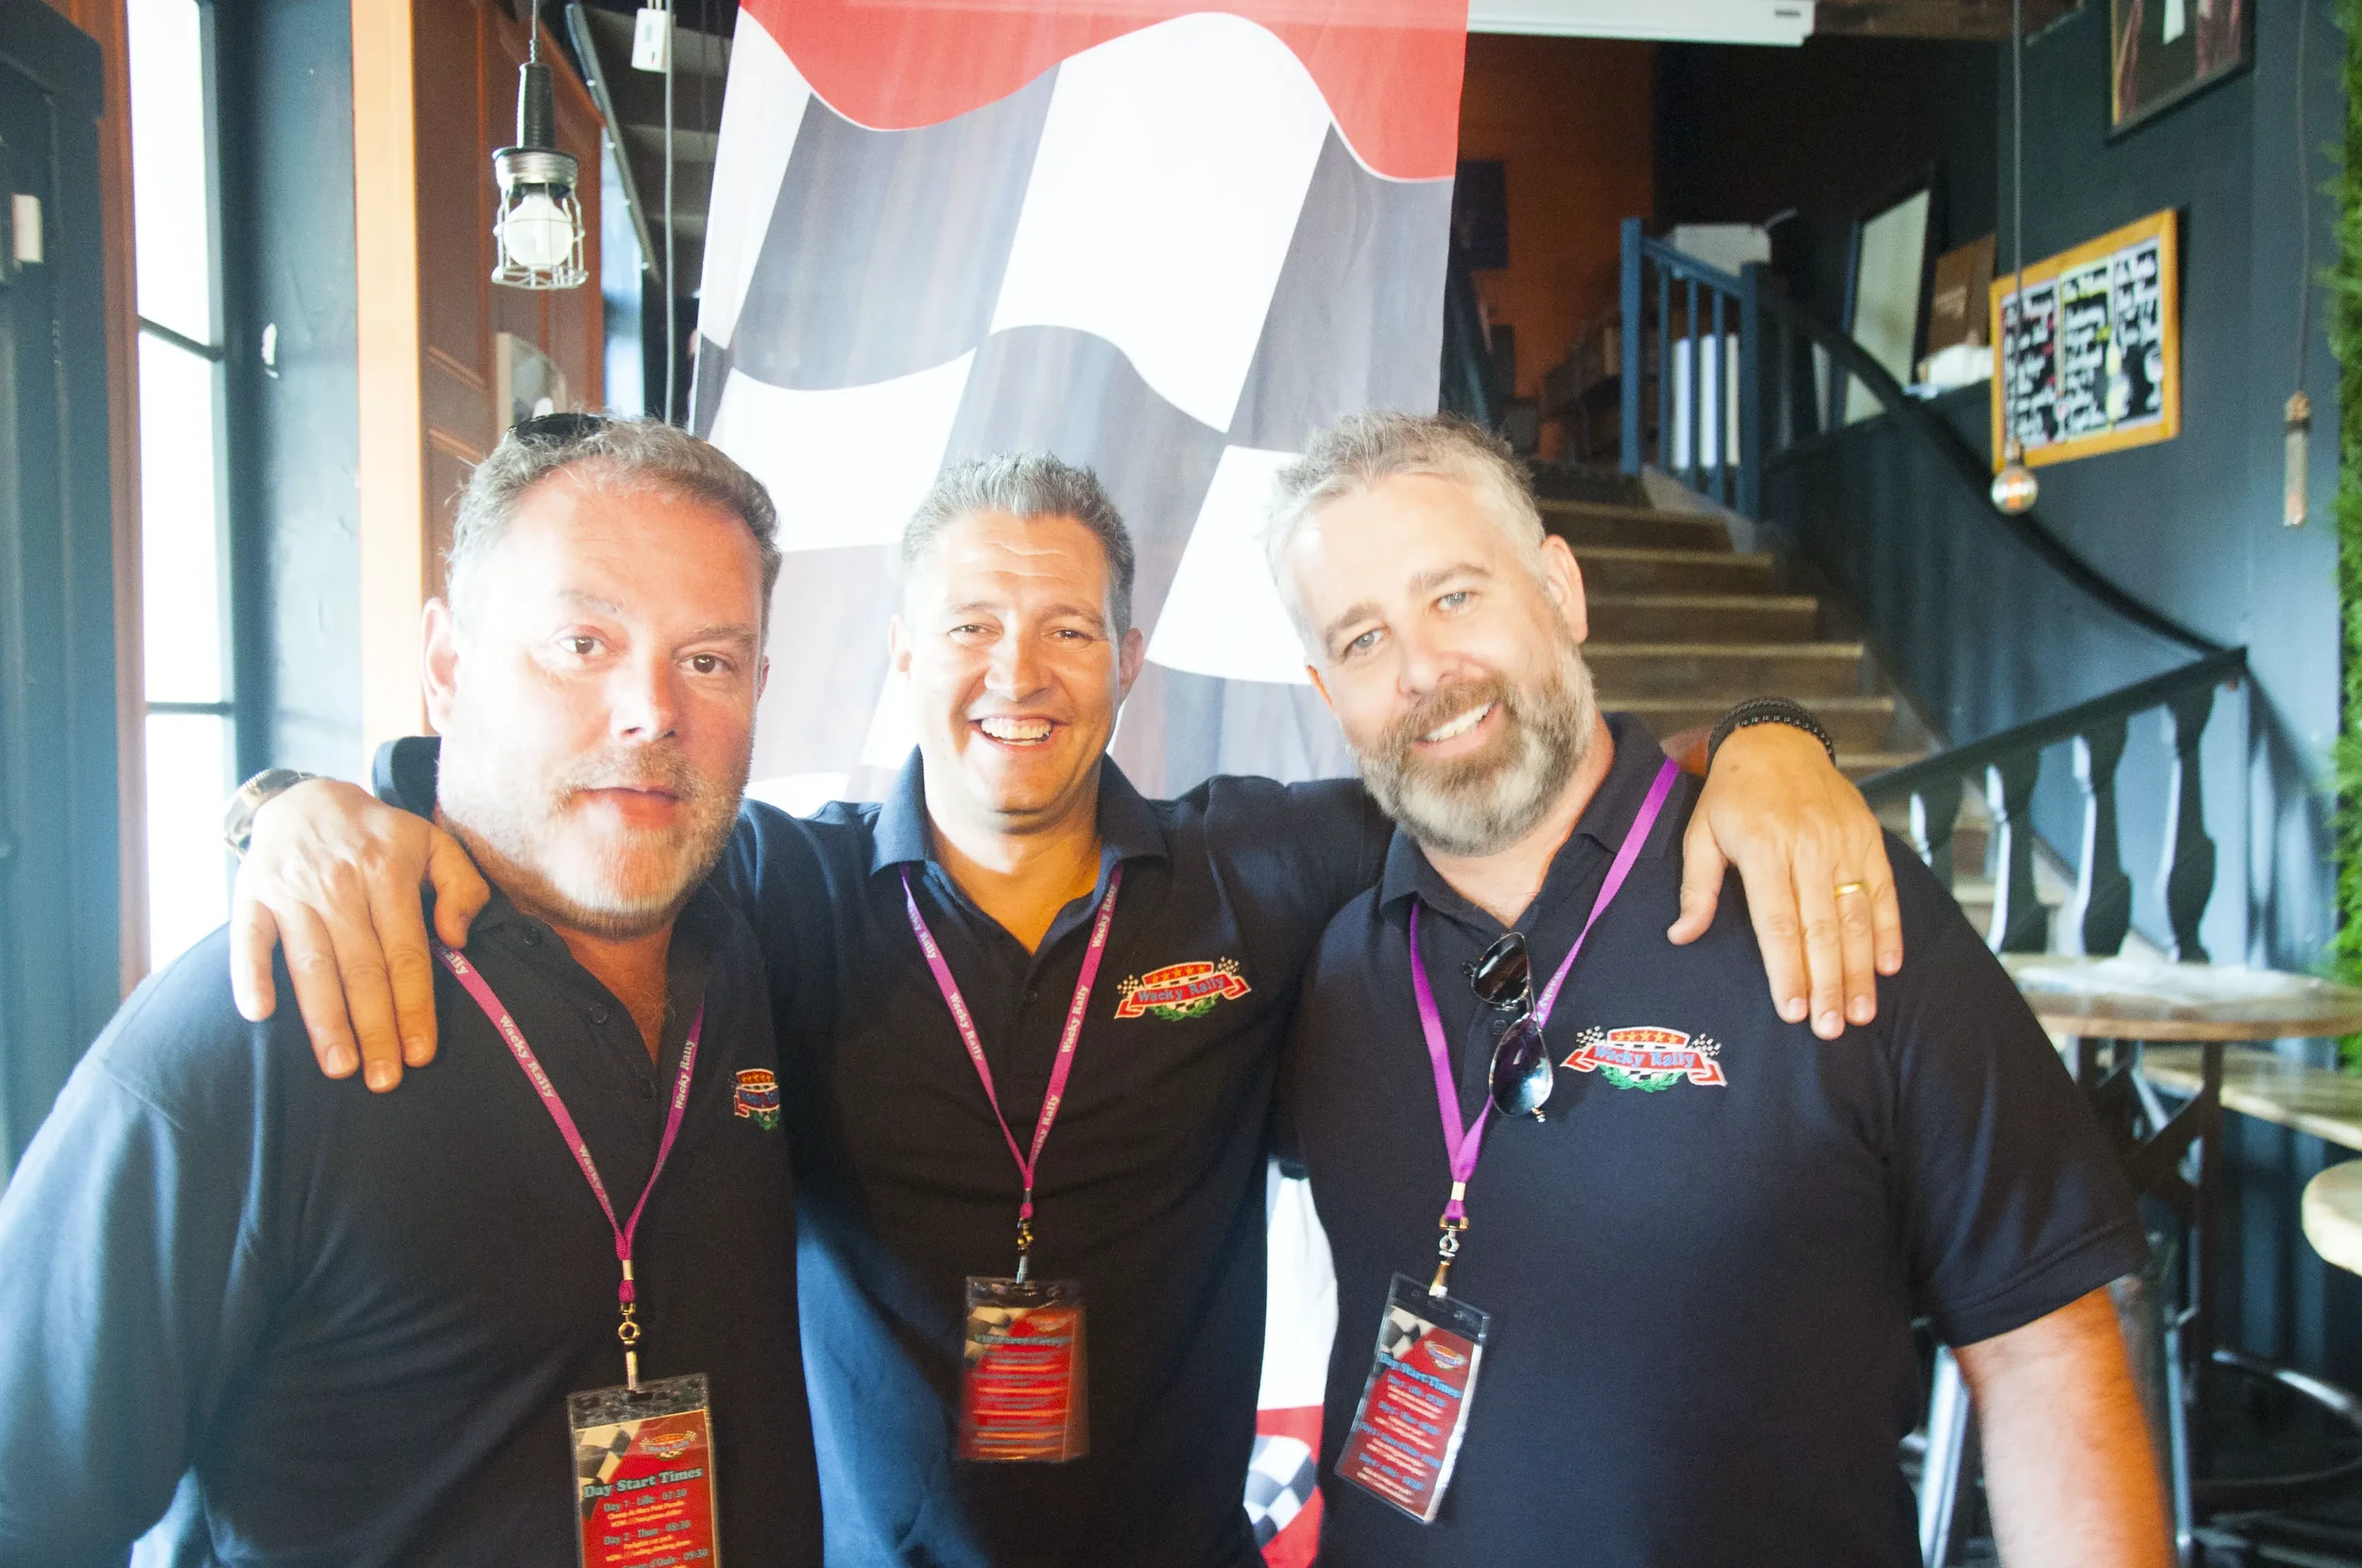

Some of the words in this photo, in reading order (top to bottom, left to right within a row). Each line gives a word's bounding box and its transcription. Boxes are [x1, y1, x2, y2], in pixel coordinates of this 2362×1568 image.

[1091, 912, 1110, 948] Wacky
[1102, 884, 1117, 912] Rally
[919, 931, 936, 960] Rally
[1071, 984, 1089, 1019] Rally
[1138, 989, 1183, 1002] Wacky
[1188, 977, 1225, 994] Rally
[949, 992, 969, 1029] Wacky
[966, 1028, 984, 1061] Rally
[1061, 1017, 1082, 1053] Wacky
[500, 1014, 529, 1060] Wacky
[527, 1059, 555, 1098] Rally
[679, 1039, 695, 1071] Rally
[1594, 1045, 1644, 1068] Wacky
[1650, 1051, 1697, 1068] Rally
[675, 1071, 691, 1110] Wacky
[1042, 1094, 1060, 1126] Rally
[1428, 1374, 1463, 1400] Times
[583, 1484, 612, 1498] Day
[616, 1475, 656, 1492] Start
[659, 1468, 703, 1484] Times
[604, 1503, 621, 1511] Day
[604, 1536, 621, 1545] Day
